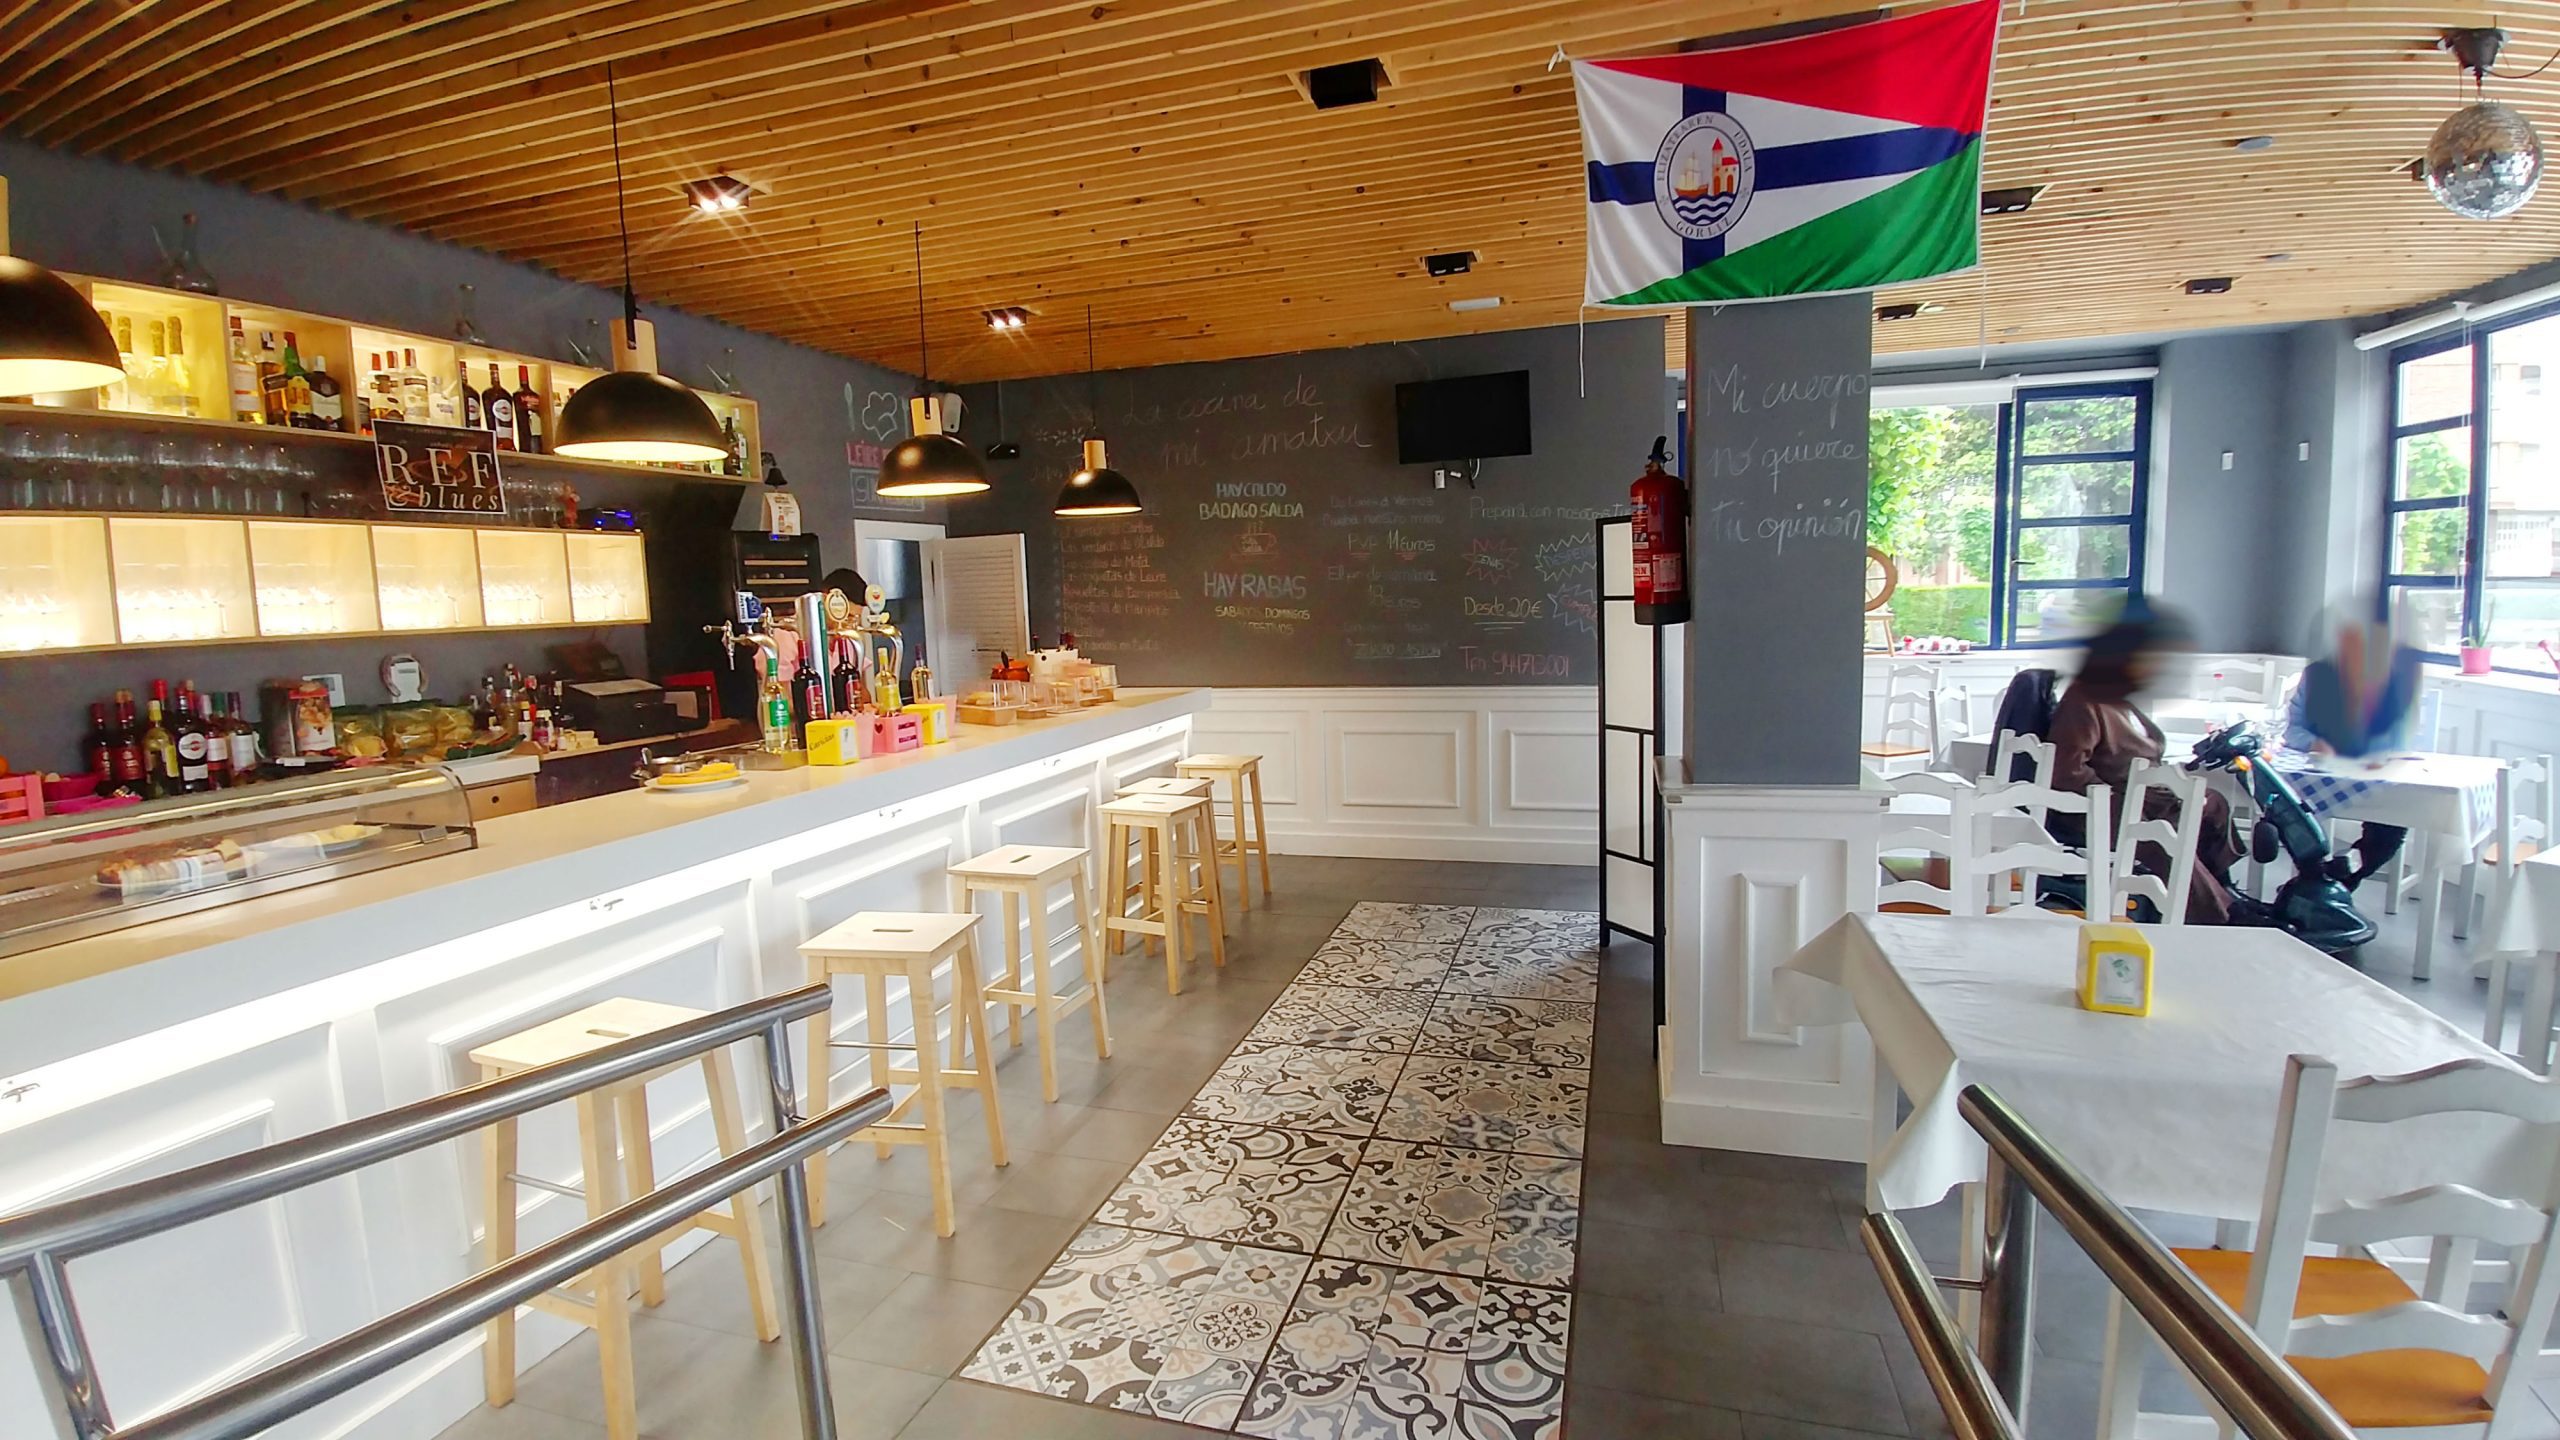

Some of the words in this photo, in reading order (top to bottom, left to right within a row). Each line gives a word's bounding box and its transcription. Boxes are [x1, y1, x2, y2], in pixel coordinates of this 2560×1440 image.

[1283, 372, 1325, 409] de
[1706, 363, 1752, 417] Mi
[1761, 373, 1868, 431] cuerpo
[378, 443, 494, 490] REF
[1761, 431, 1864, 495] quiere
[418, 484, 499, 511] blues
[1199, 502, 1258, 521] BADAGO
[1259, 502, 1305, 519] SALDA
[1757, 497, 1862, 557] opinión
[1203, 570, 1239, 598] HAY
[1241, 573, 1307, 600] RABAS
[1464, 596, 1504, 617] Desde
